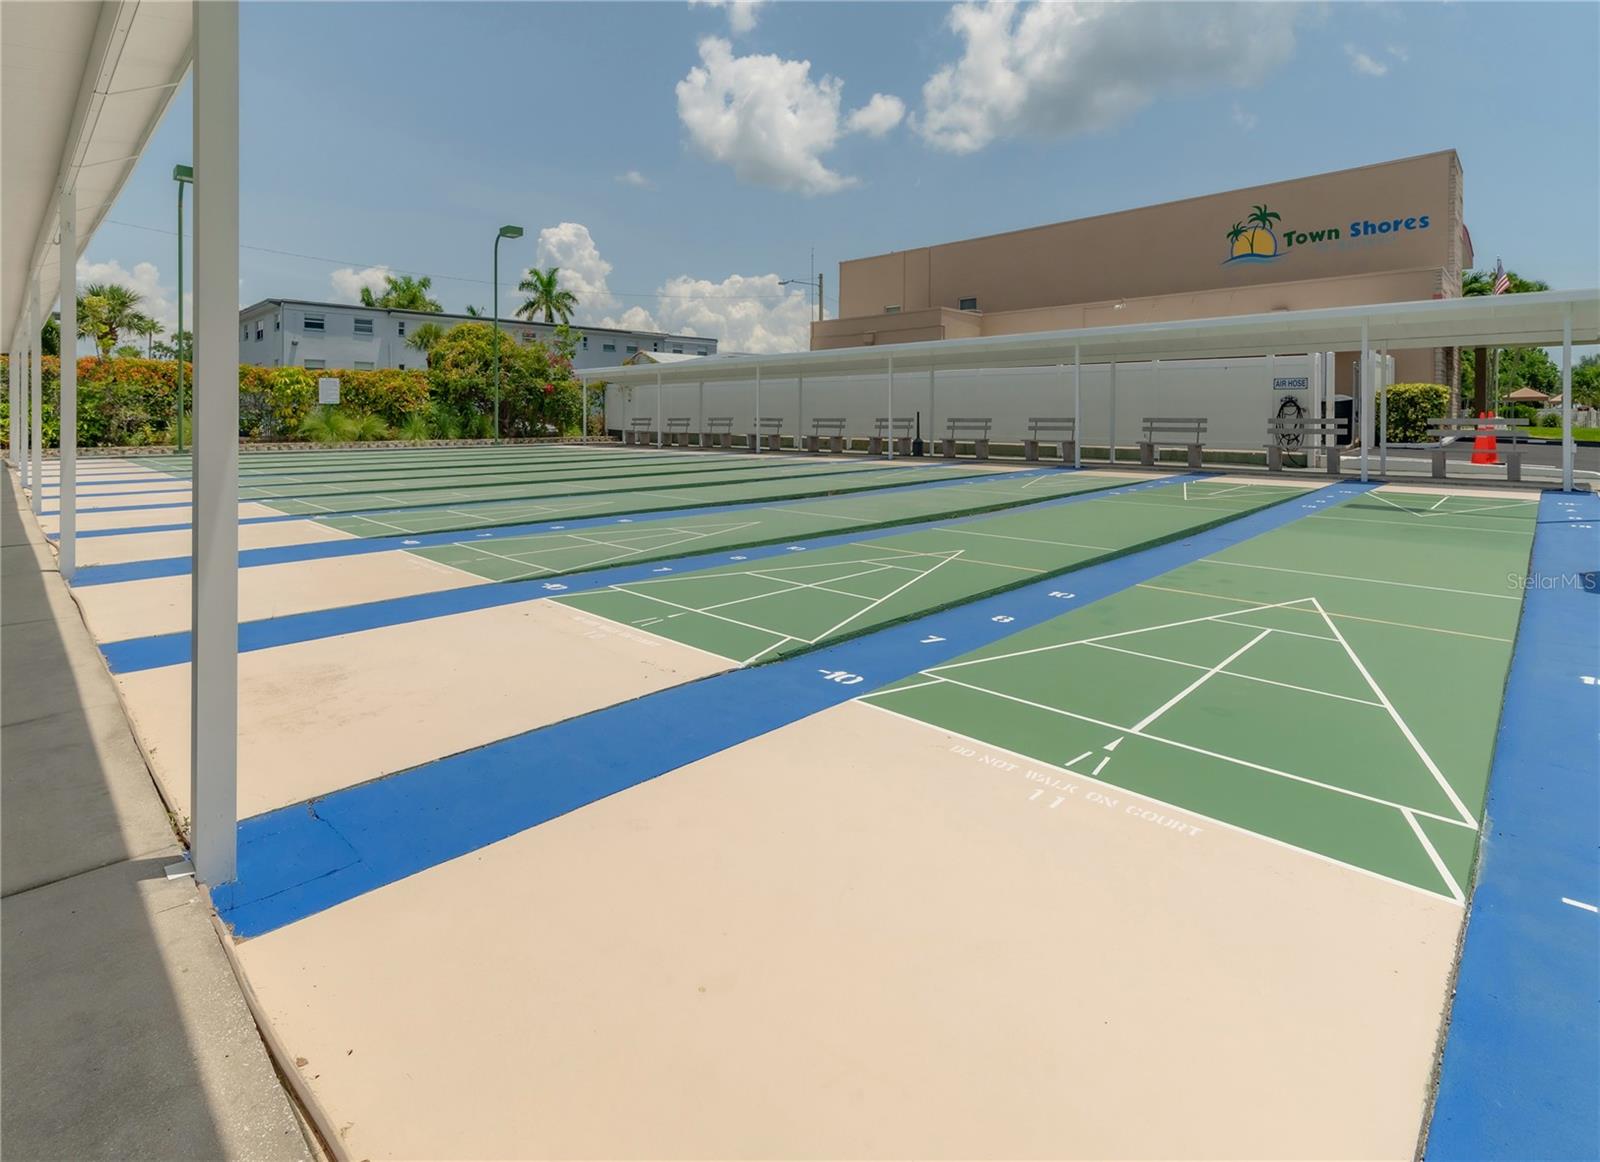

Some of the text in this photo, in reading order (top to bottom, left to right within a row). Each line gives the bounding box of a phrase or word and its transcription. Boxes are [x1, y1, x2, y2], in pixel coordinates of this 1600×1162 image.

[1283, 228, 1340, 248] Town
[1350, 215, 1429, 238] Shores
[1275, 380, 1306, 388] AIR HOSE
[1048, 591, 1076, 599] 10
[950, 745, 1204, 838] DO NOT WALK ON COURT
